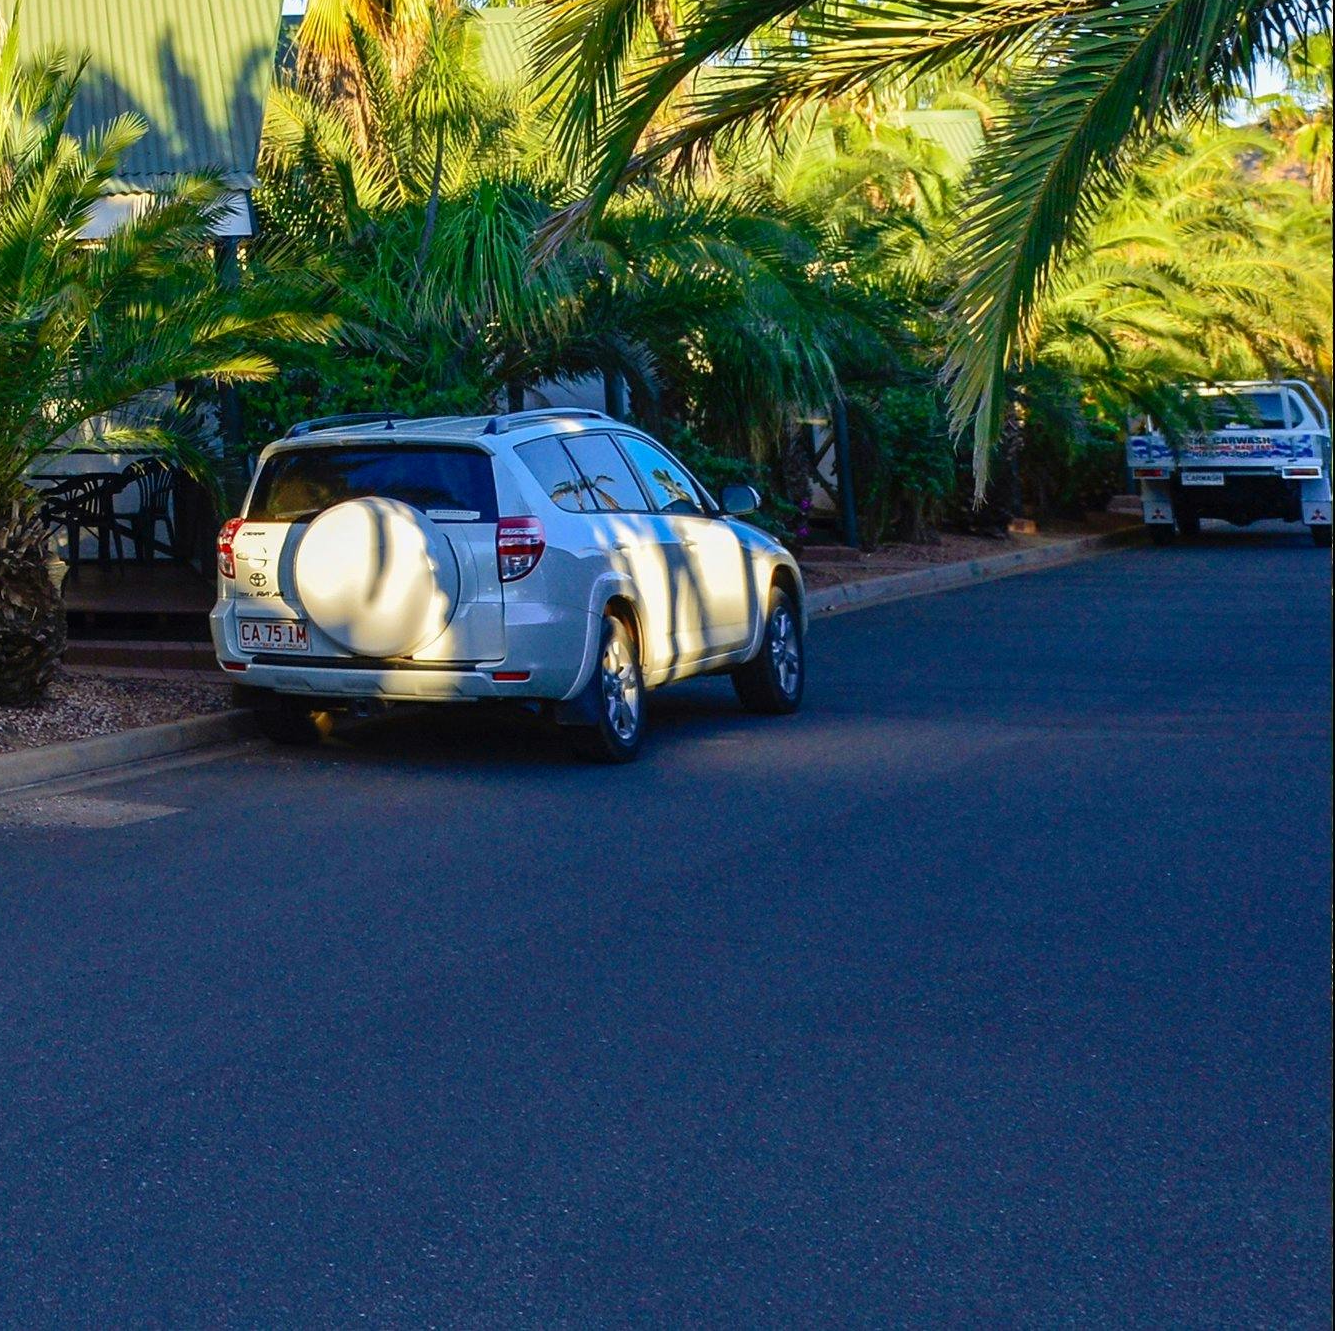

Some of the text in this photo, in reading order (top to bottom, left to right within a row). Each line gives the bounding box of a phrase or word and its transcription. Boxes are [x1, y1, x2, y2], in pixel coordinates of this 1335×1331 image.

[1213, 436, 1271, 444] CARWASH
[241, 624, 307, 643] CA 75 IM
